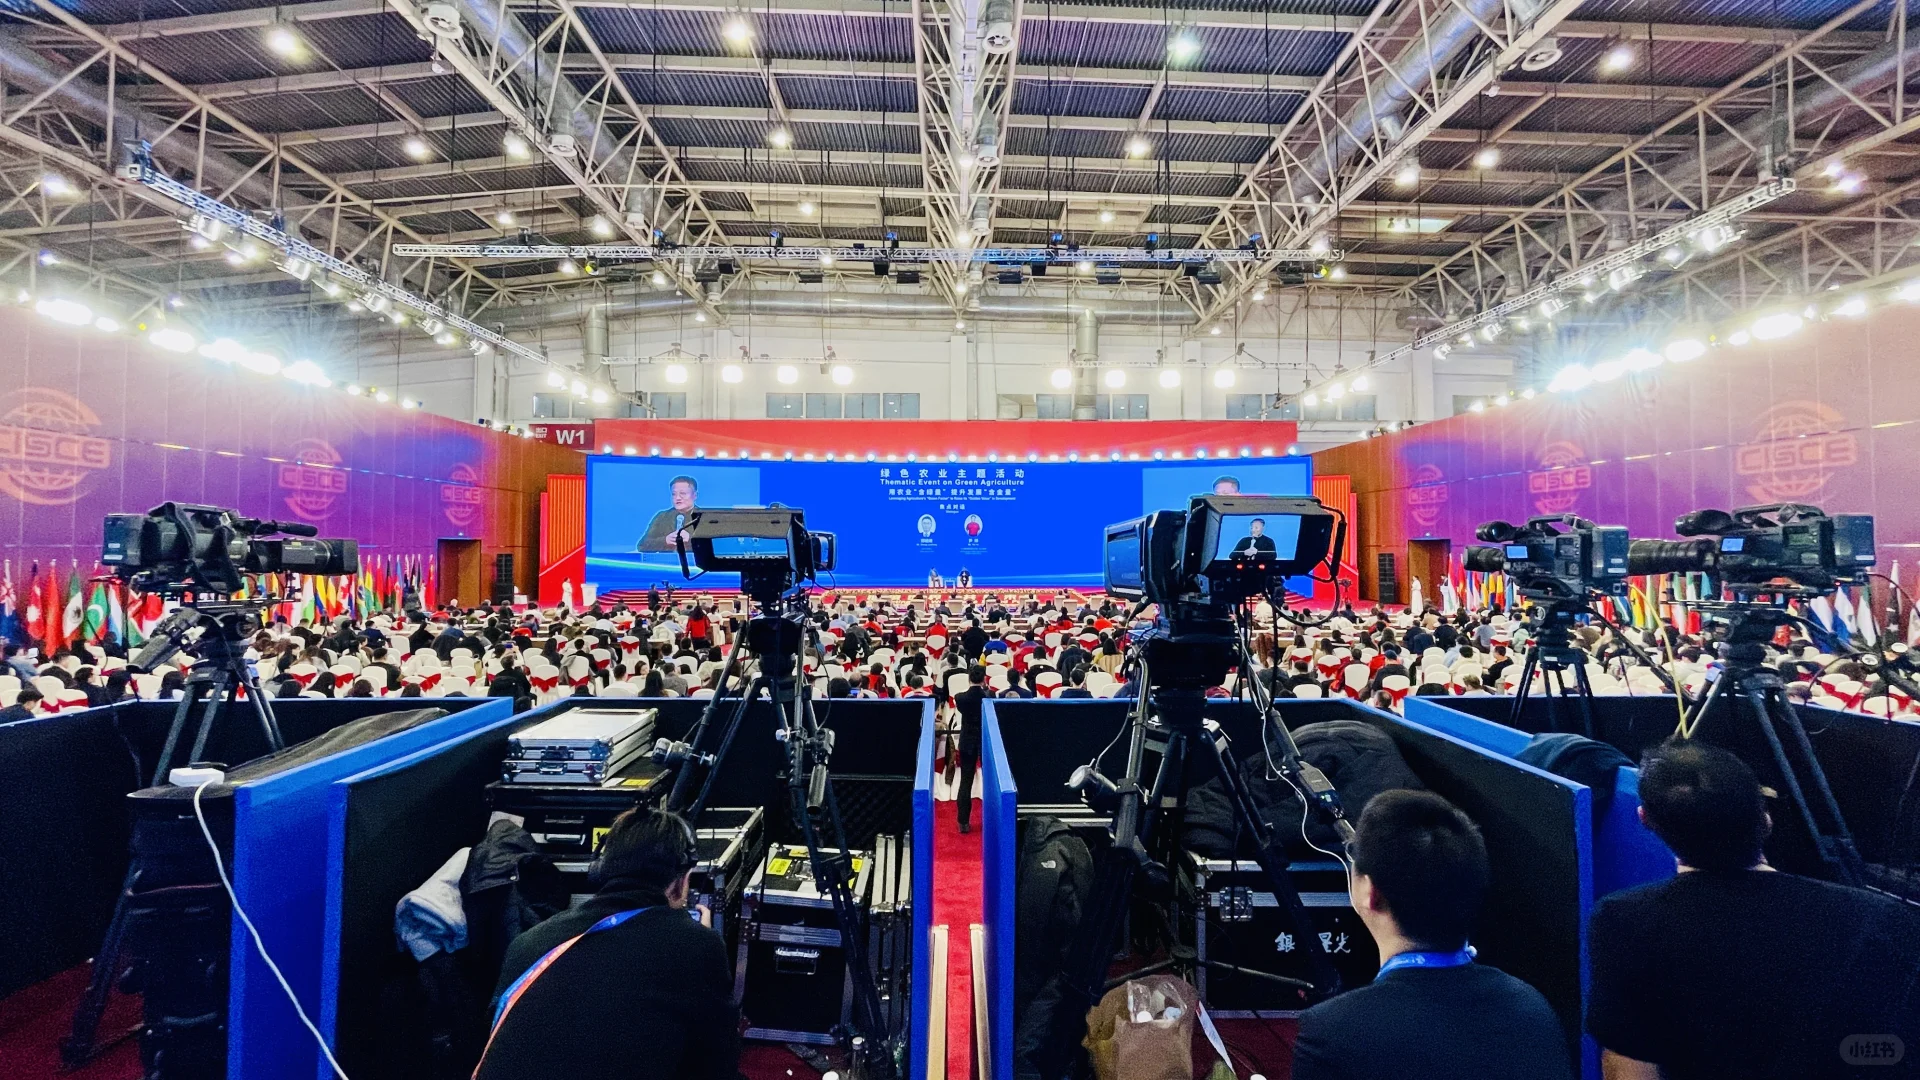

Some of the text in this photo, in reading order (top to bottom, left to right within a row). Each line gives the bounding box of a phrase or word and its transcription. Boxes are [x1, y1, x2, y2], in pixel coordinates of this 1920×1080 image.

[556, 430, 585, 445] W1
[1741, 439, 1851, 470] CISCE
[282, 467, 344, 491] CISCE
[880, 468, 1025, 478] 绿色农业主题活动
[1531, 468, 1589, 491] CISCE
[980, 479, 1024, 487] Agriculture
